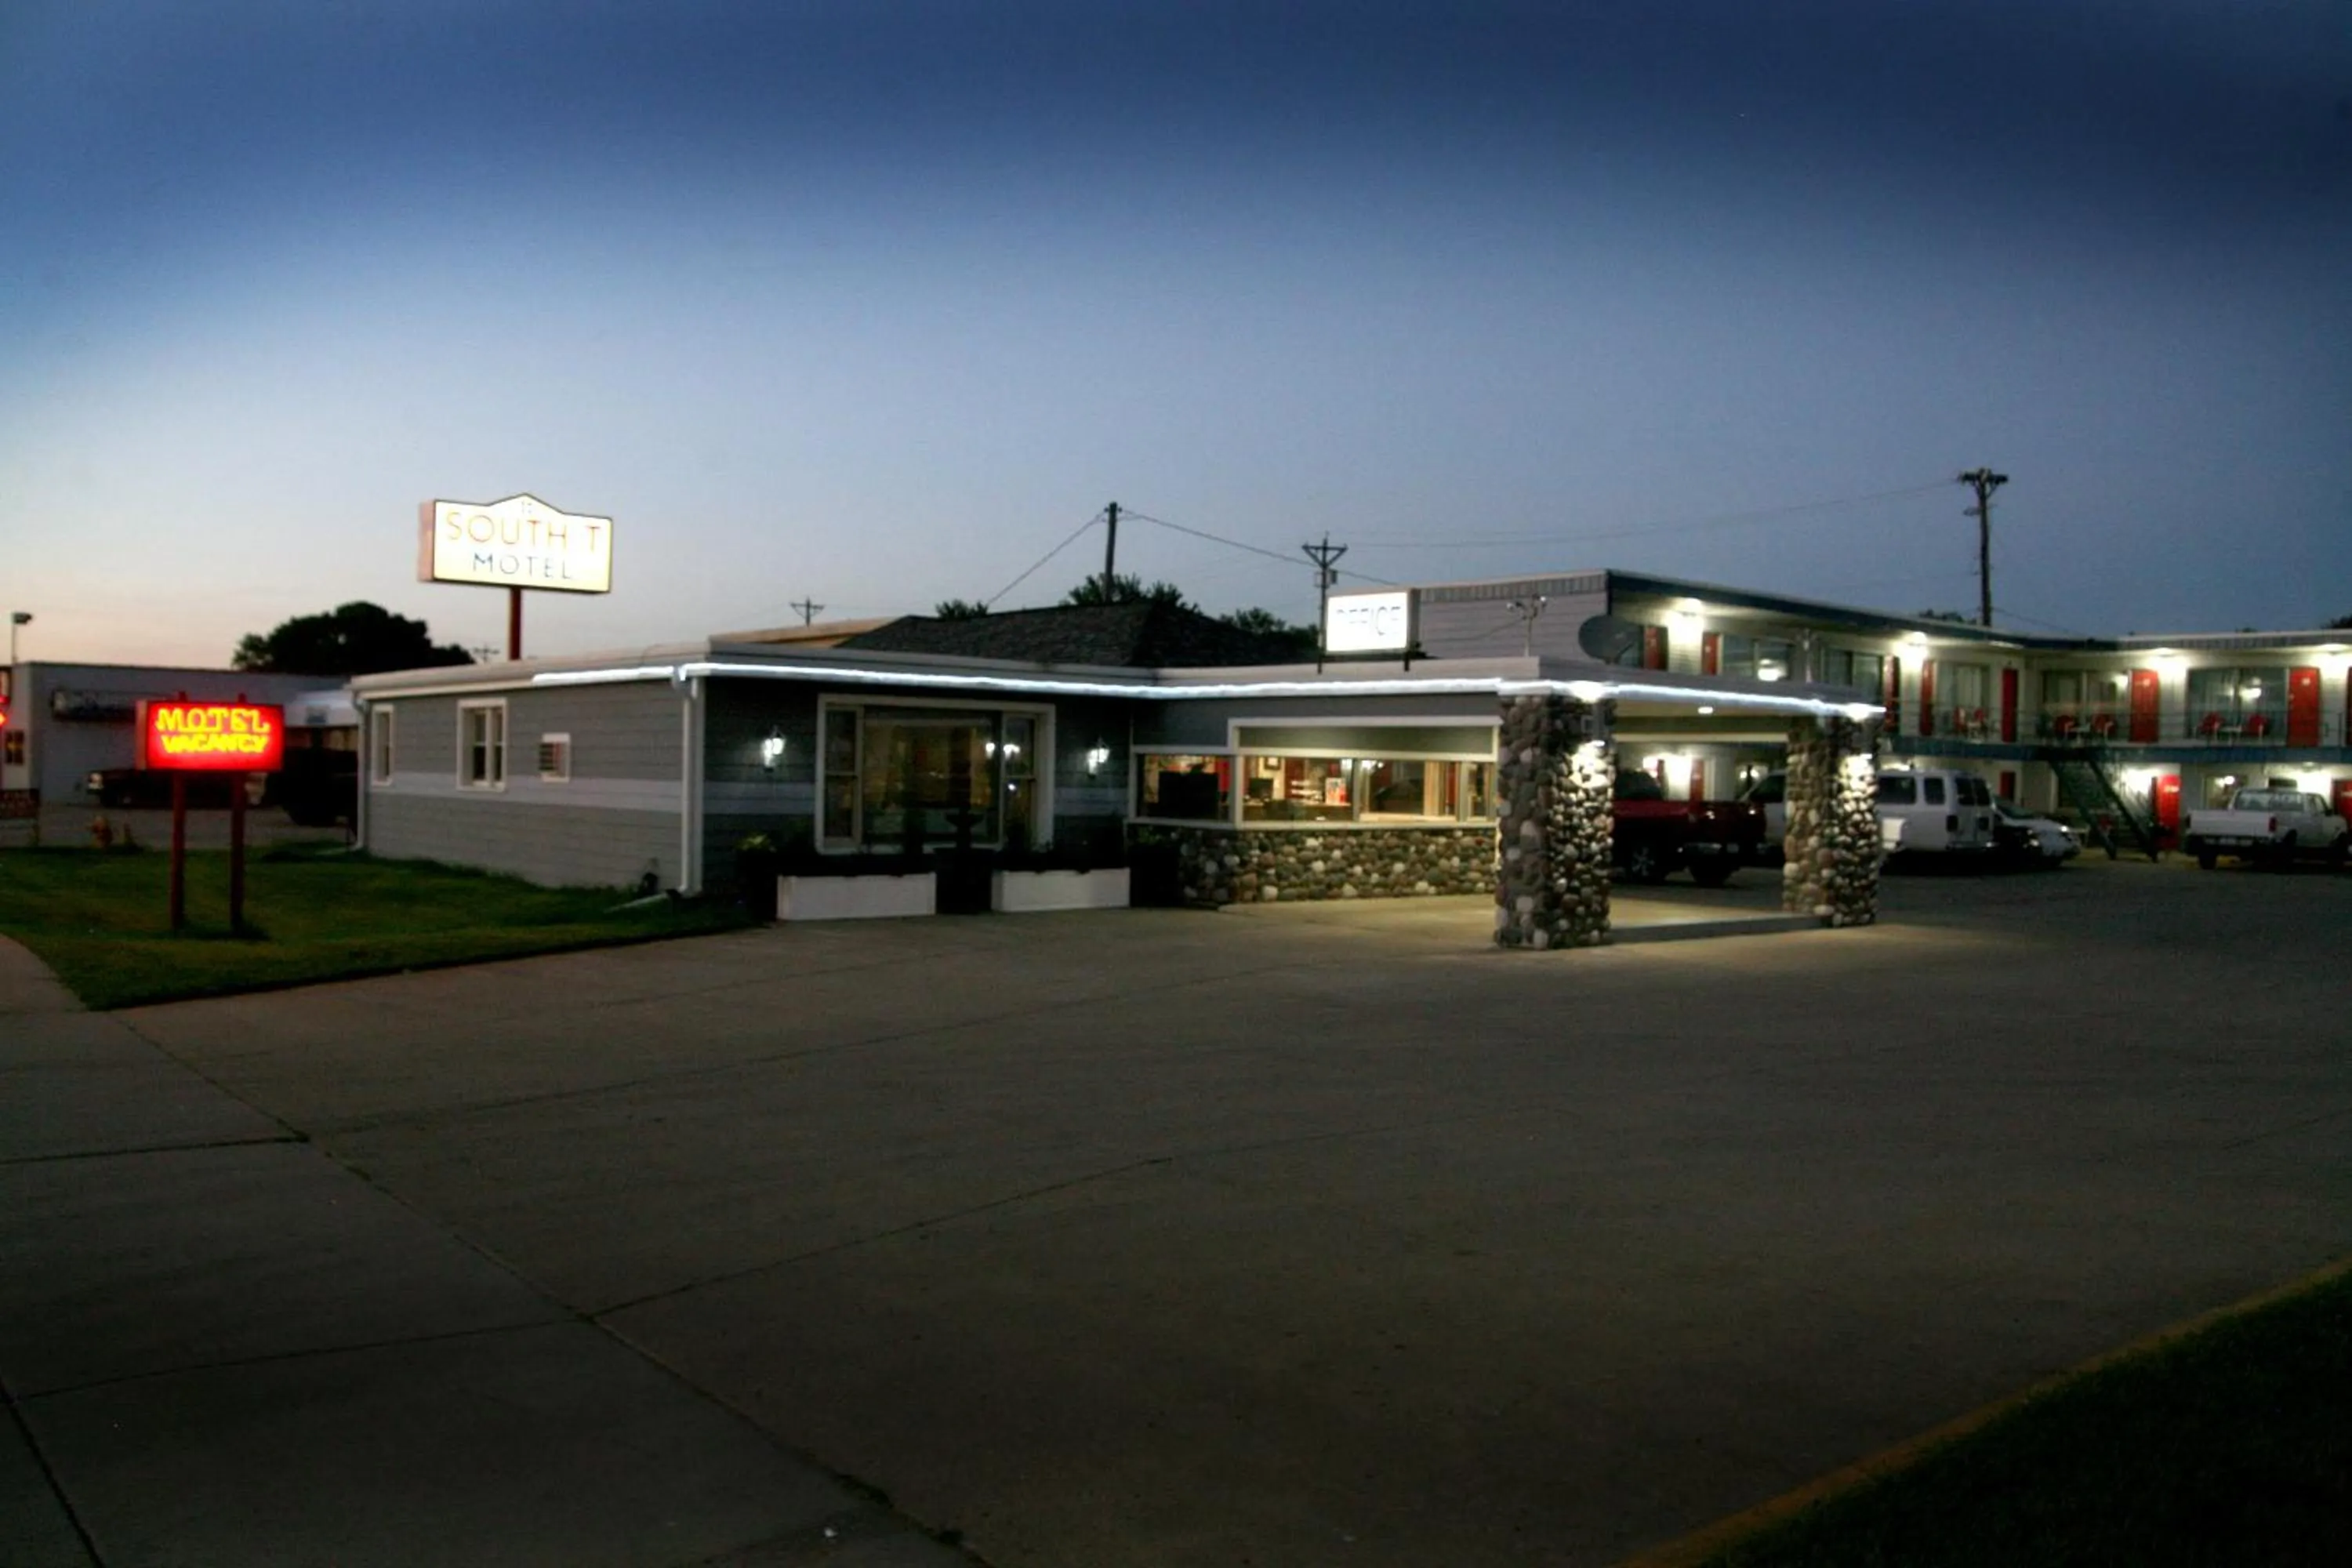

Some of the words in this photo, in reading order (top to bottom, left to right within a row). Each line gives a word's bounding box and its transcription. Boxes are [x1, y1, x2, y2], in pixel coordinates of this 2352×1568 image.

[445, 511, 567, 549] SOUTH
[472, 552, 574, 580] MOTEL
[156, 707, 270, 732] MOTEL
[162, 733, 269, 753] VACANCY
